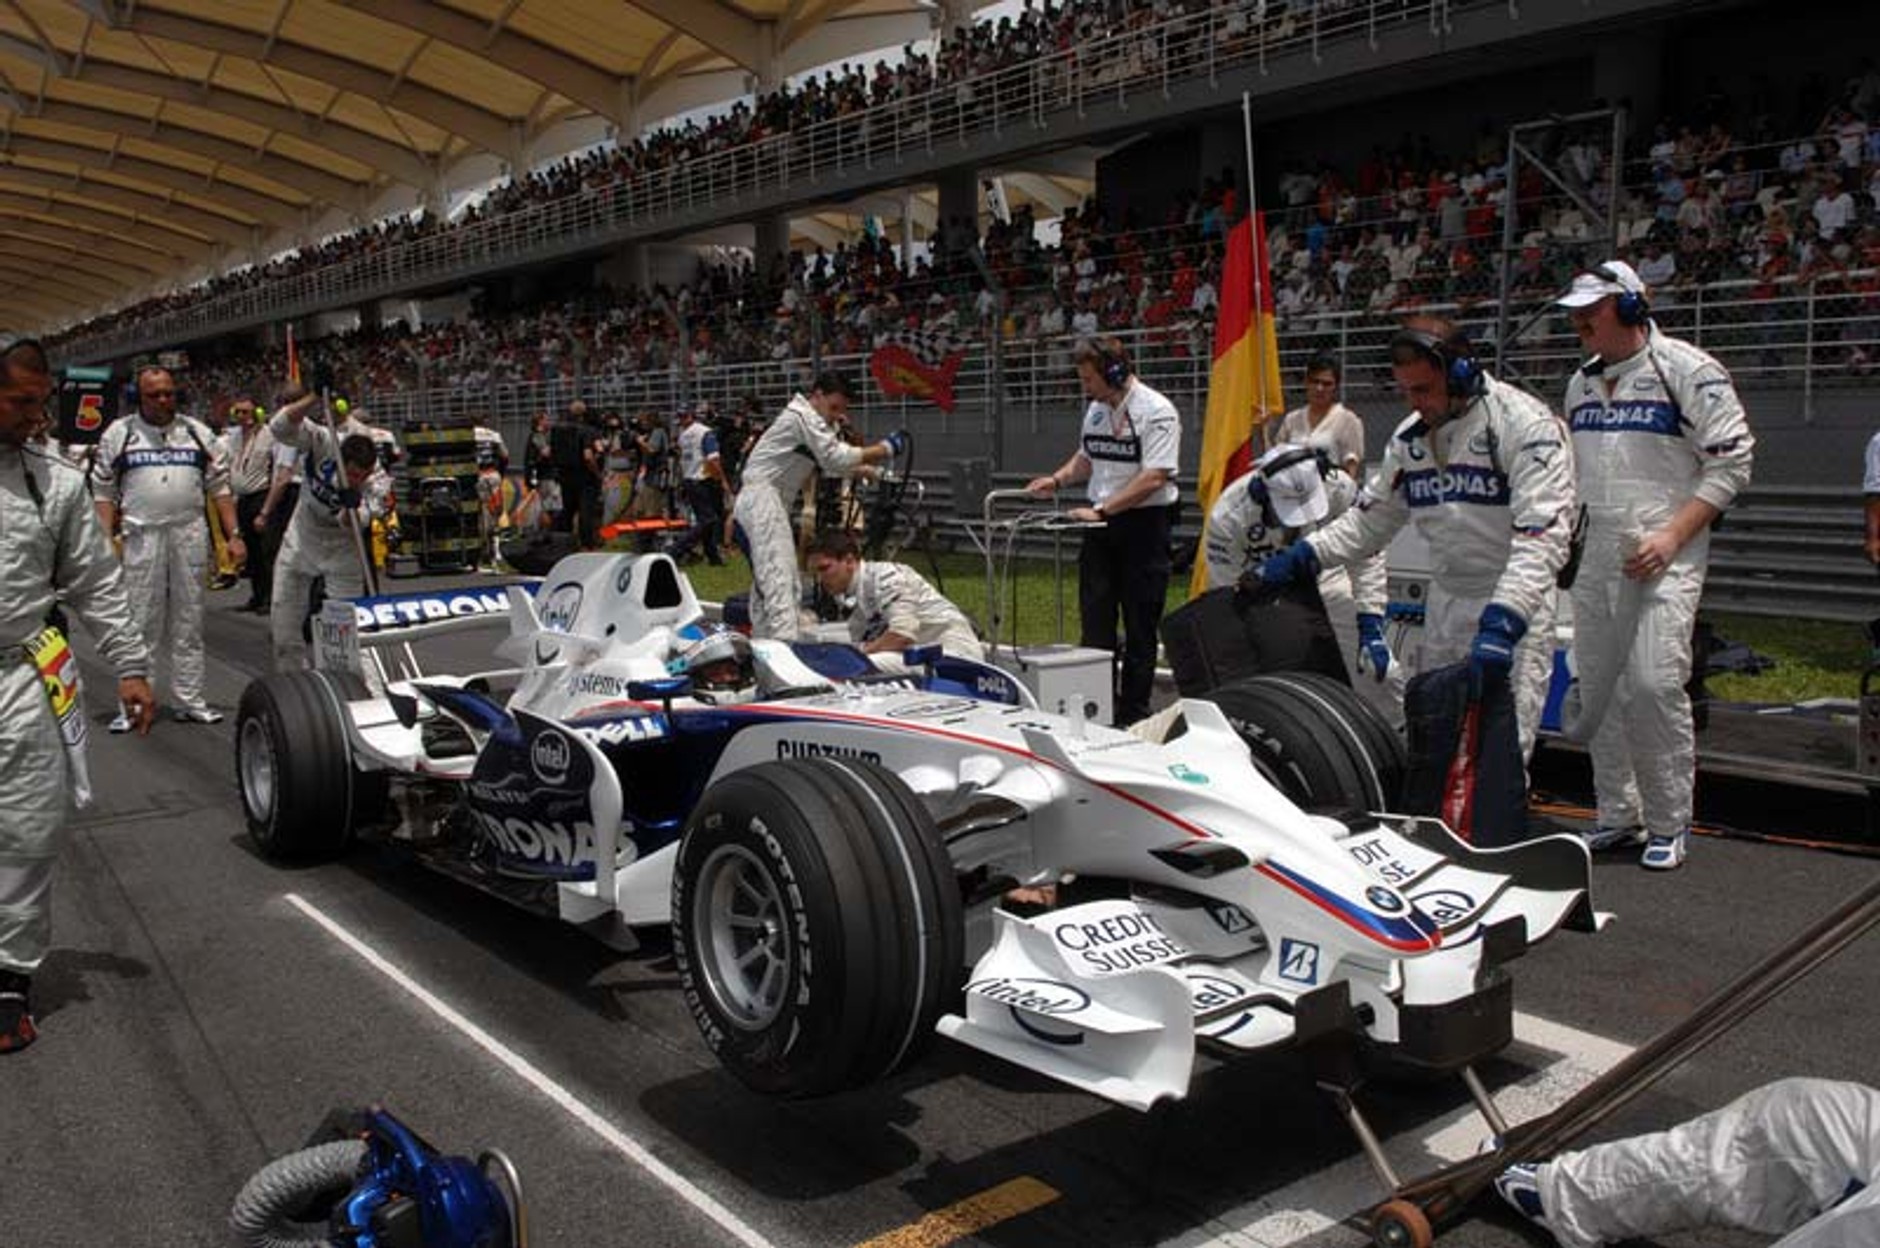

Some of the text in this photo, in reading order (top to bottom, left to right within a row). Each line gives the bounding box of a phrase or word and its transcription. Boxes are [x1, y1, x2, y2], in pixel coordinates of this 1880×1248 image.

[76, 394, 103, 431] 5
[355, 592, 511, 627] PETRON
[1350, 838, 1390, 866] DIT
[1055, 912, 1163, 950] CREDIT
[1082, 938, 1186, 972] SUISSE
